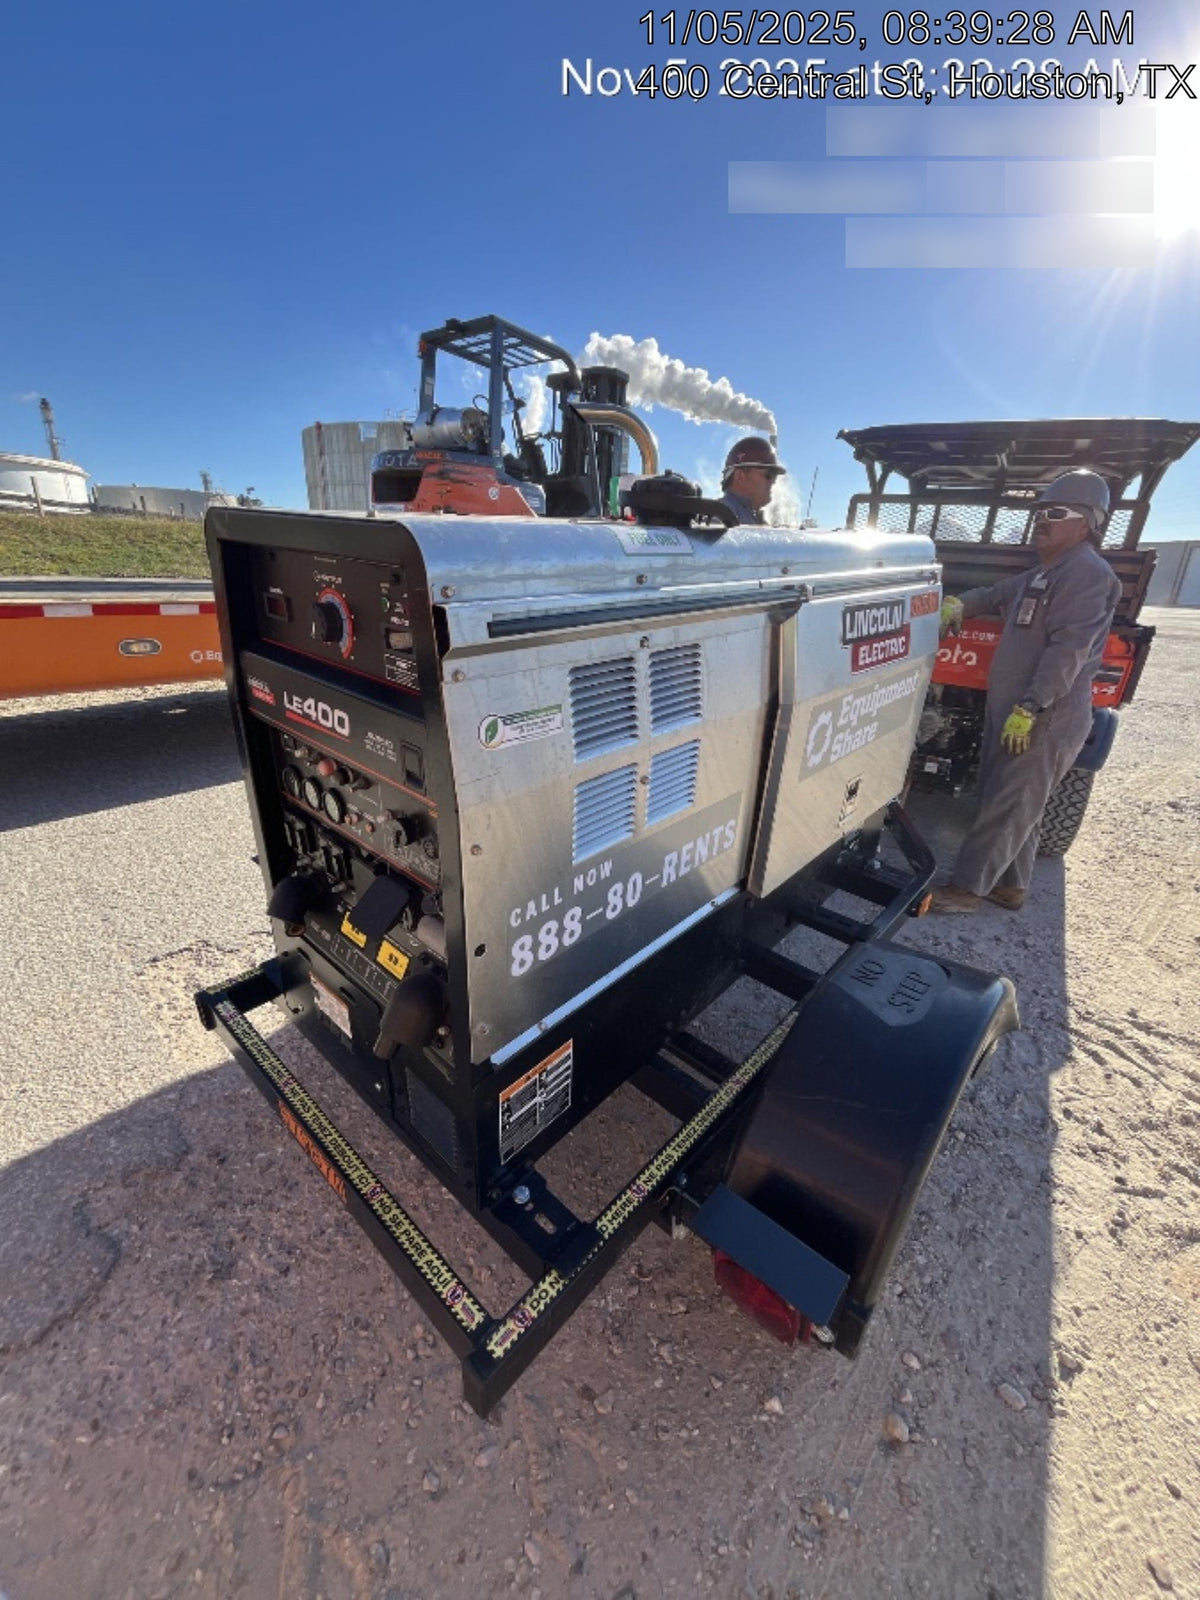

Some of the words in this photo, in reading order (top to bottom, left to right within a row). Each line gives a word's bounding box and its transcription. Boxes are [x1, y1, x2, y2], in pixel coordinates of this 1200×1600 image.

[845, 603, 904, 640] LINCOLN
[858, 635, 907, 666] ELECTRIC
[283, 690, 350, 737] LE400
[837, 669, 921, 727] Equipment
[829, 721, 880, 764] Share
[509, 886, 563, 928] CALL
[573, 858, 613, 895] NOW
[510, 818, 737, 977] 888-80-RENTS
[849, 959, 887, 988] NO
[887, 970, 933, 1014] STEP
[376, 1198, 393, 1216] NO
[389, 1214, 406, 1231] SE
[400, 1229, 429, 1260] PARE
